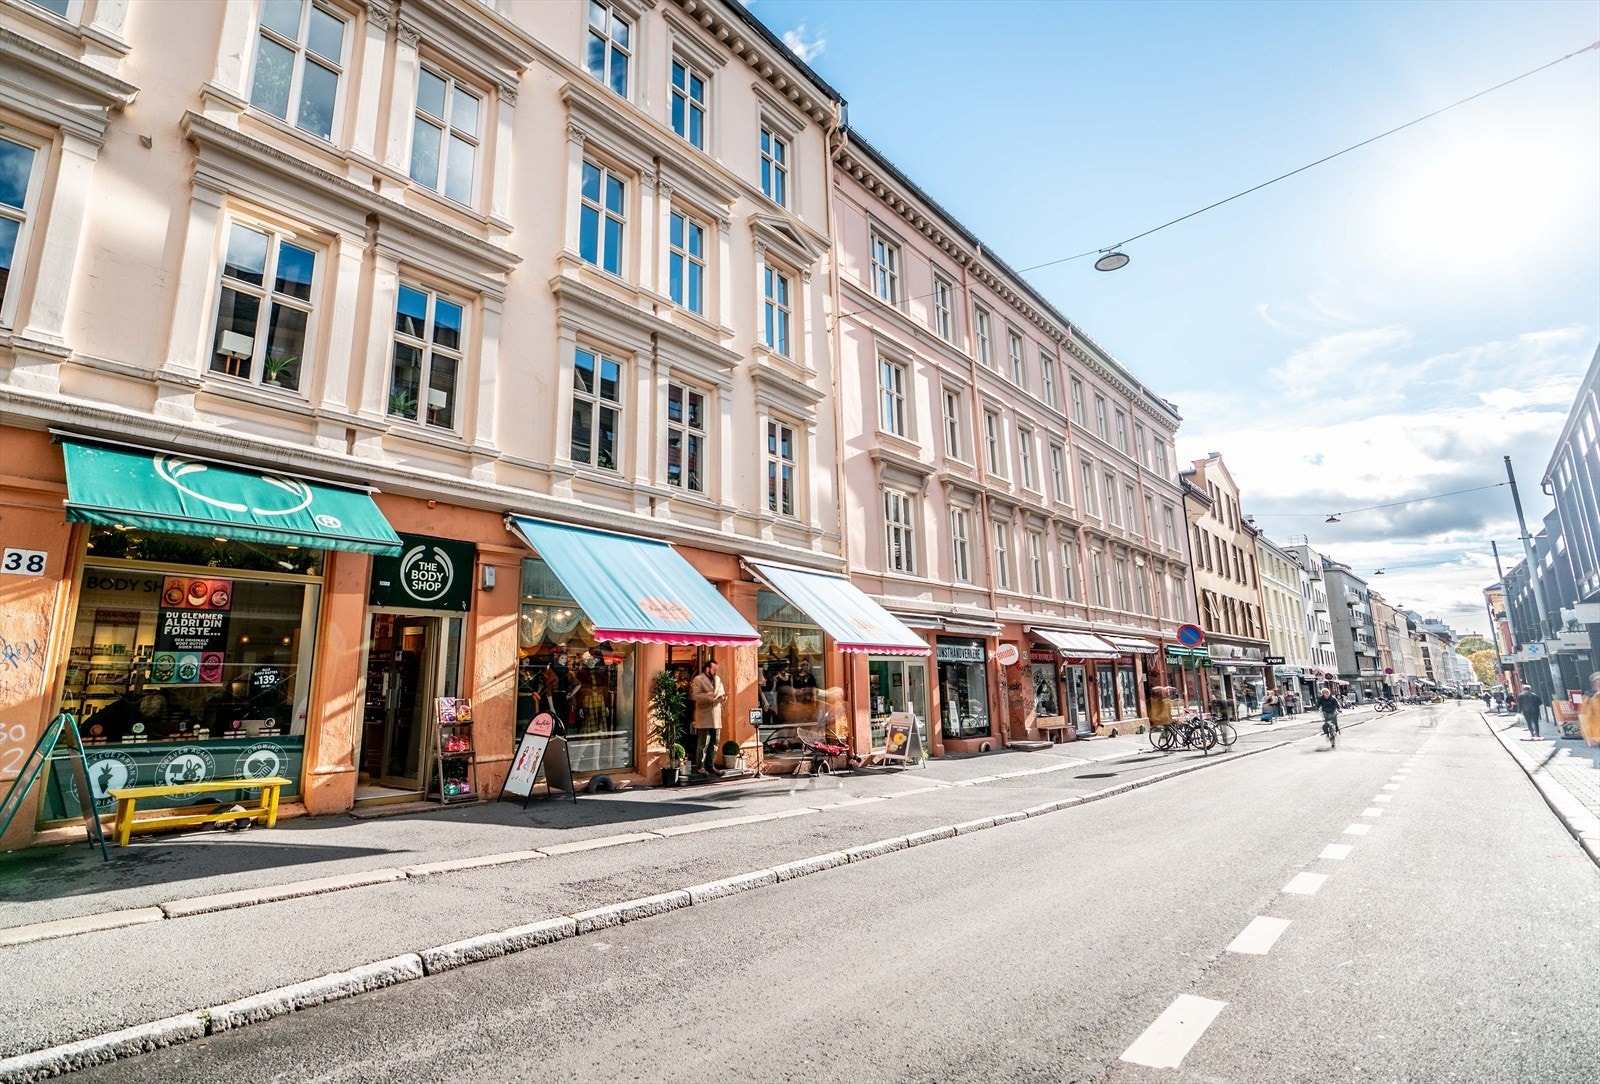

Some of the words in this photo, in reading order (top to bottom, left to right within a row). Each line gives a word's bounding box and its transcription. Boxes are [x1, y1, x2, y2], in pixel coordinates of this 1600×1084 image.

[4, 552, 44, 573] 38
[418, 561, 438, 572] THE
[411, 569, 445, 582] BODY
[86, 576, 140, 592] BODY
[143, 580, 163, 593] SH
[411, 580, 442, 592] SHOP
[165, 611, 179, 619] DU
[181, 612, 223, 620] GLEMMER
[165, 618, 200, 627] ALDRI
[202, 619, 222, 628] DIN
[163, 626, 221, 636] FØRSTE...
[936, 645, 981, 660] UNSTHANDVERKERE
[247, 743, 280, 755] GROWING
[91, 751, 136, 776] VEGETARIAN
[158, 747, 189, 773] FOREVER
[190, 747, 214, 769] AGAINST
